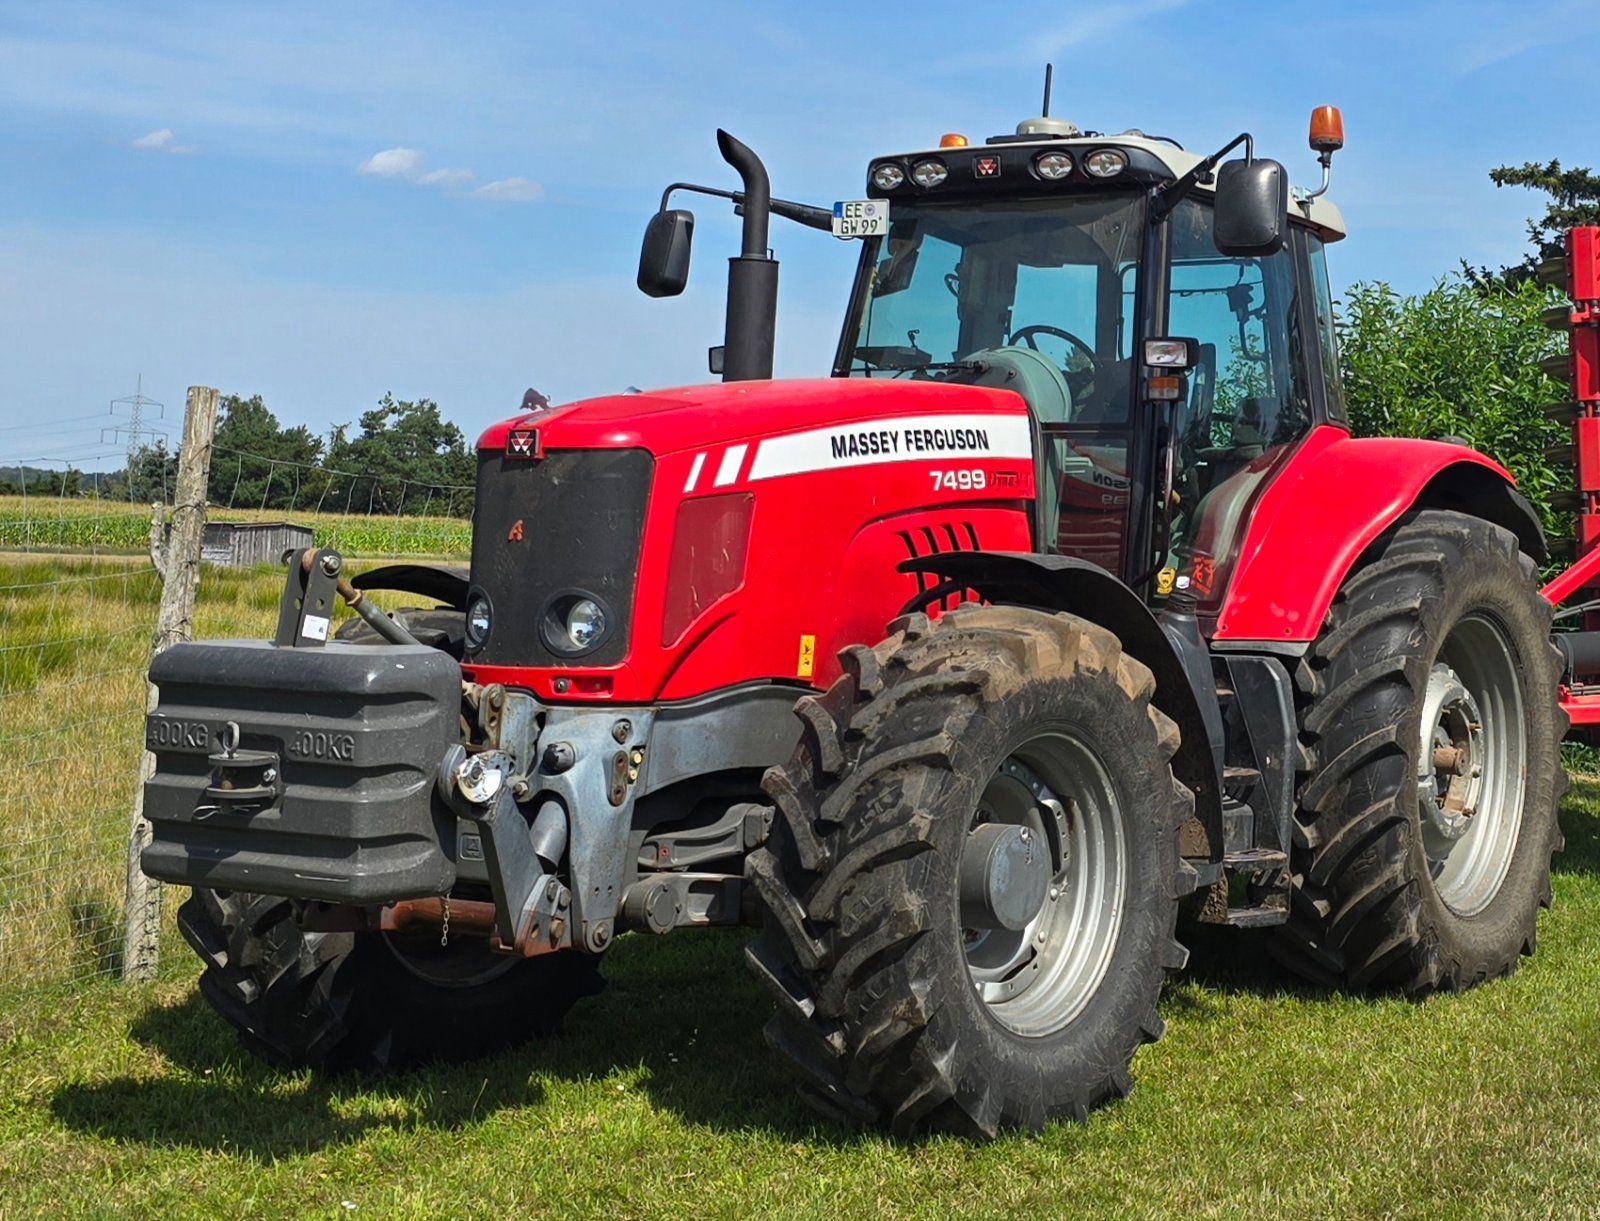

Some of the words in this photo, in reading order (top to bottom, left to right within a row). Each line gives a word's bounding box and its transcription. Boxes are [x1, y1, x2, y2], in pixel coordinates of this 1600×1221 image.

[845, 204, 862, 218] EE
[841, 220, 858, 234] GW
[861, 219, 878, 233] 99
[831, 431, 899, 459] MASSEY
[904, 430, 989, 452] FERGUSON
[929, 470, 986, 491] 7499
[290, 730, 356, 760] 400KG
